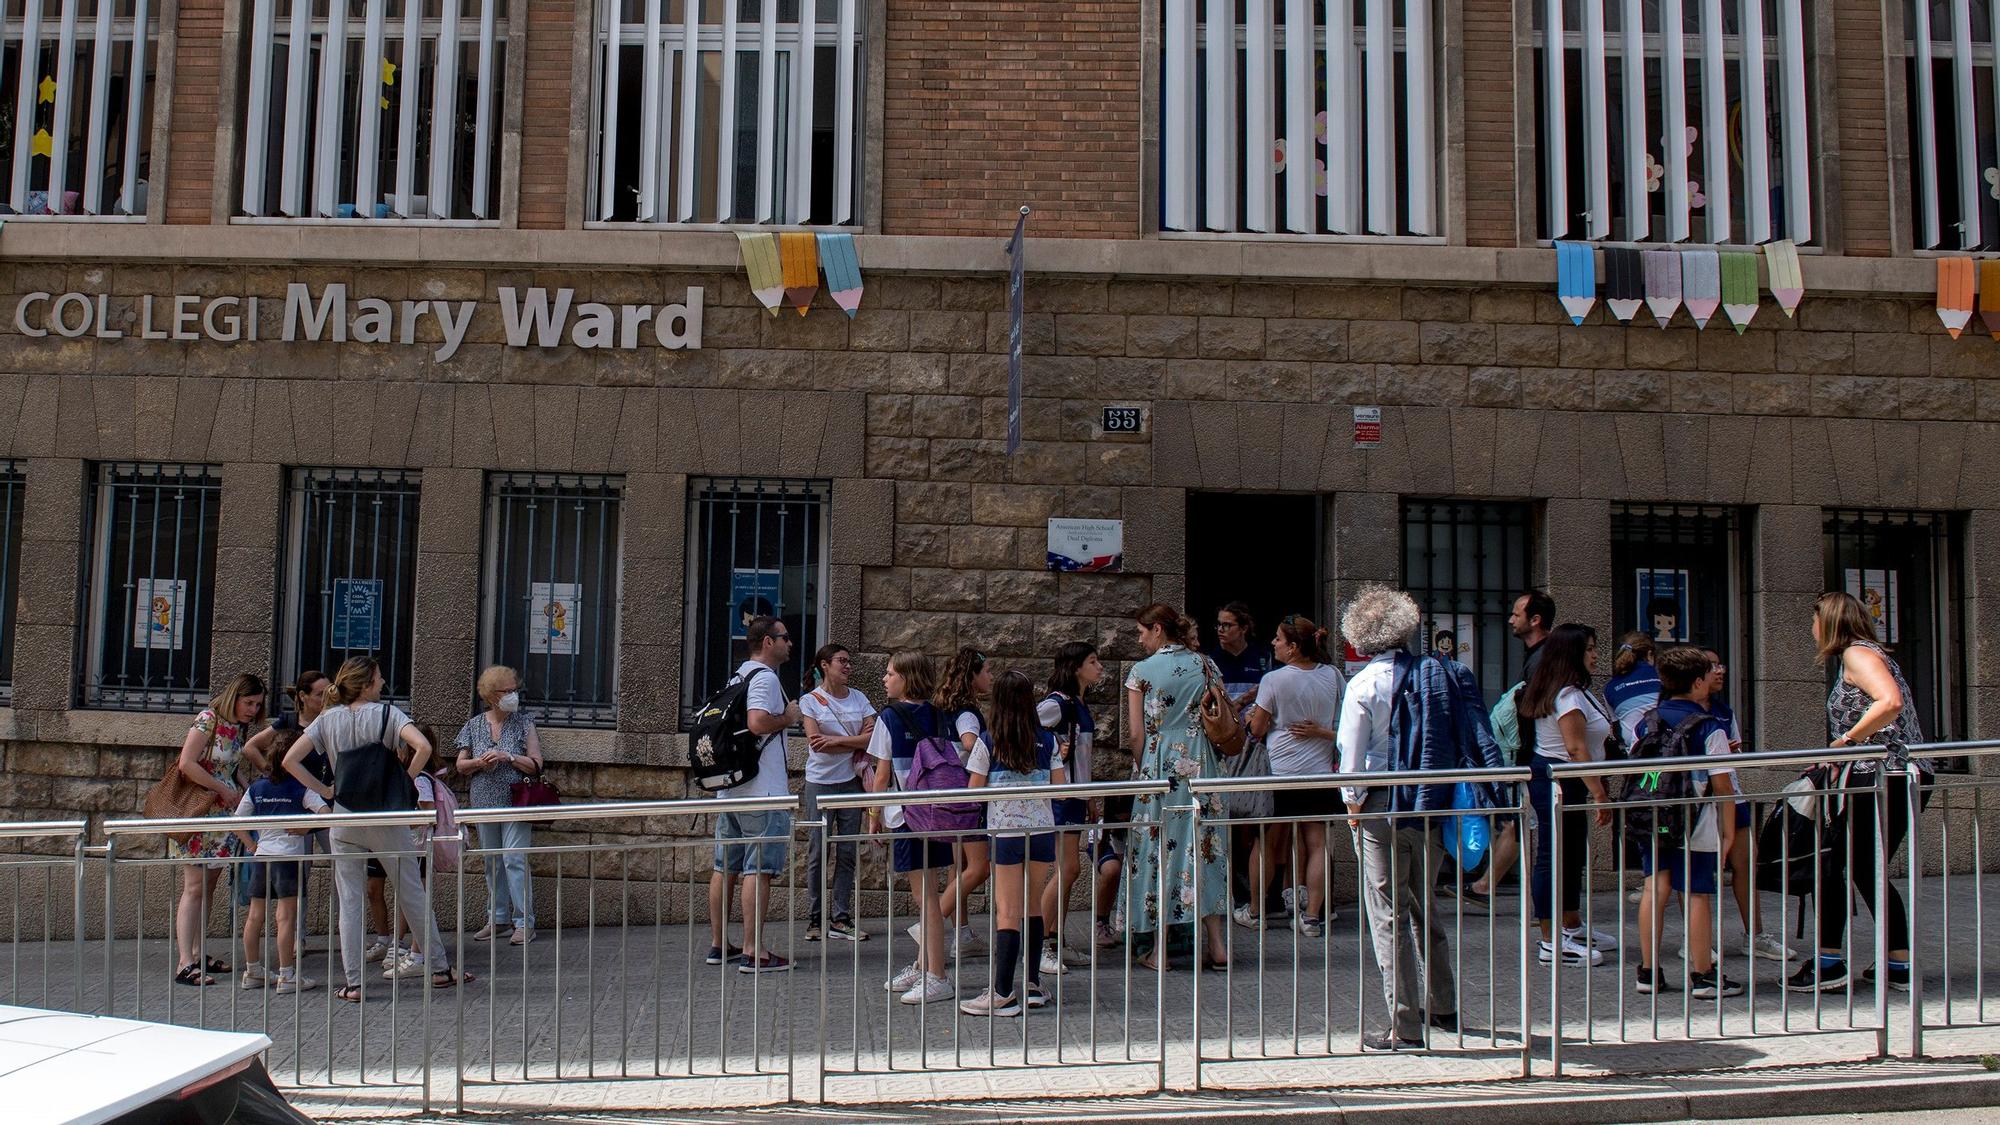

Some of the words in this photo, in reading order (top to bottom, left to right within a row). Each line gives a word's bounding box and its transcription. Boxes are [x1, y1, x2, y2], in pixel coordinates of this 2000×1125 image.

[281, 282, 477, 363] Mary
[498, 285, 705, 350] Ward
[1108, 410, 1136, 429] 55
[1081, 524, 1095, 532] High
